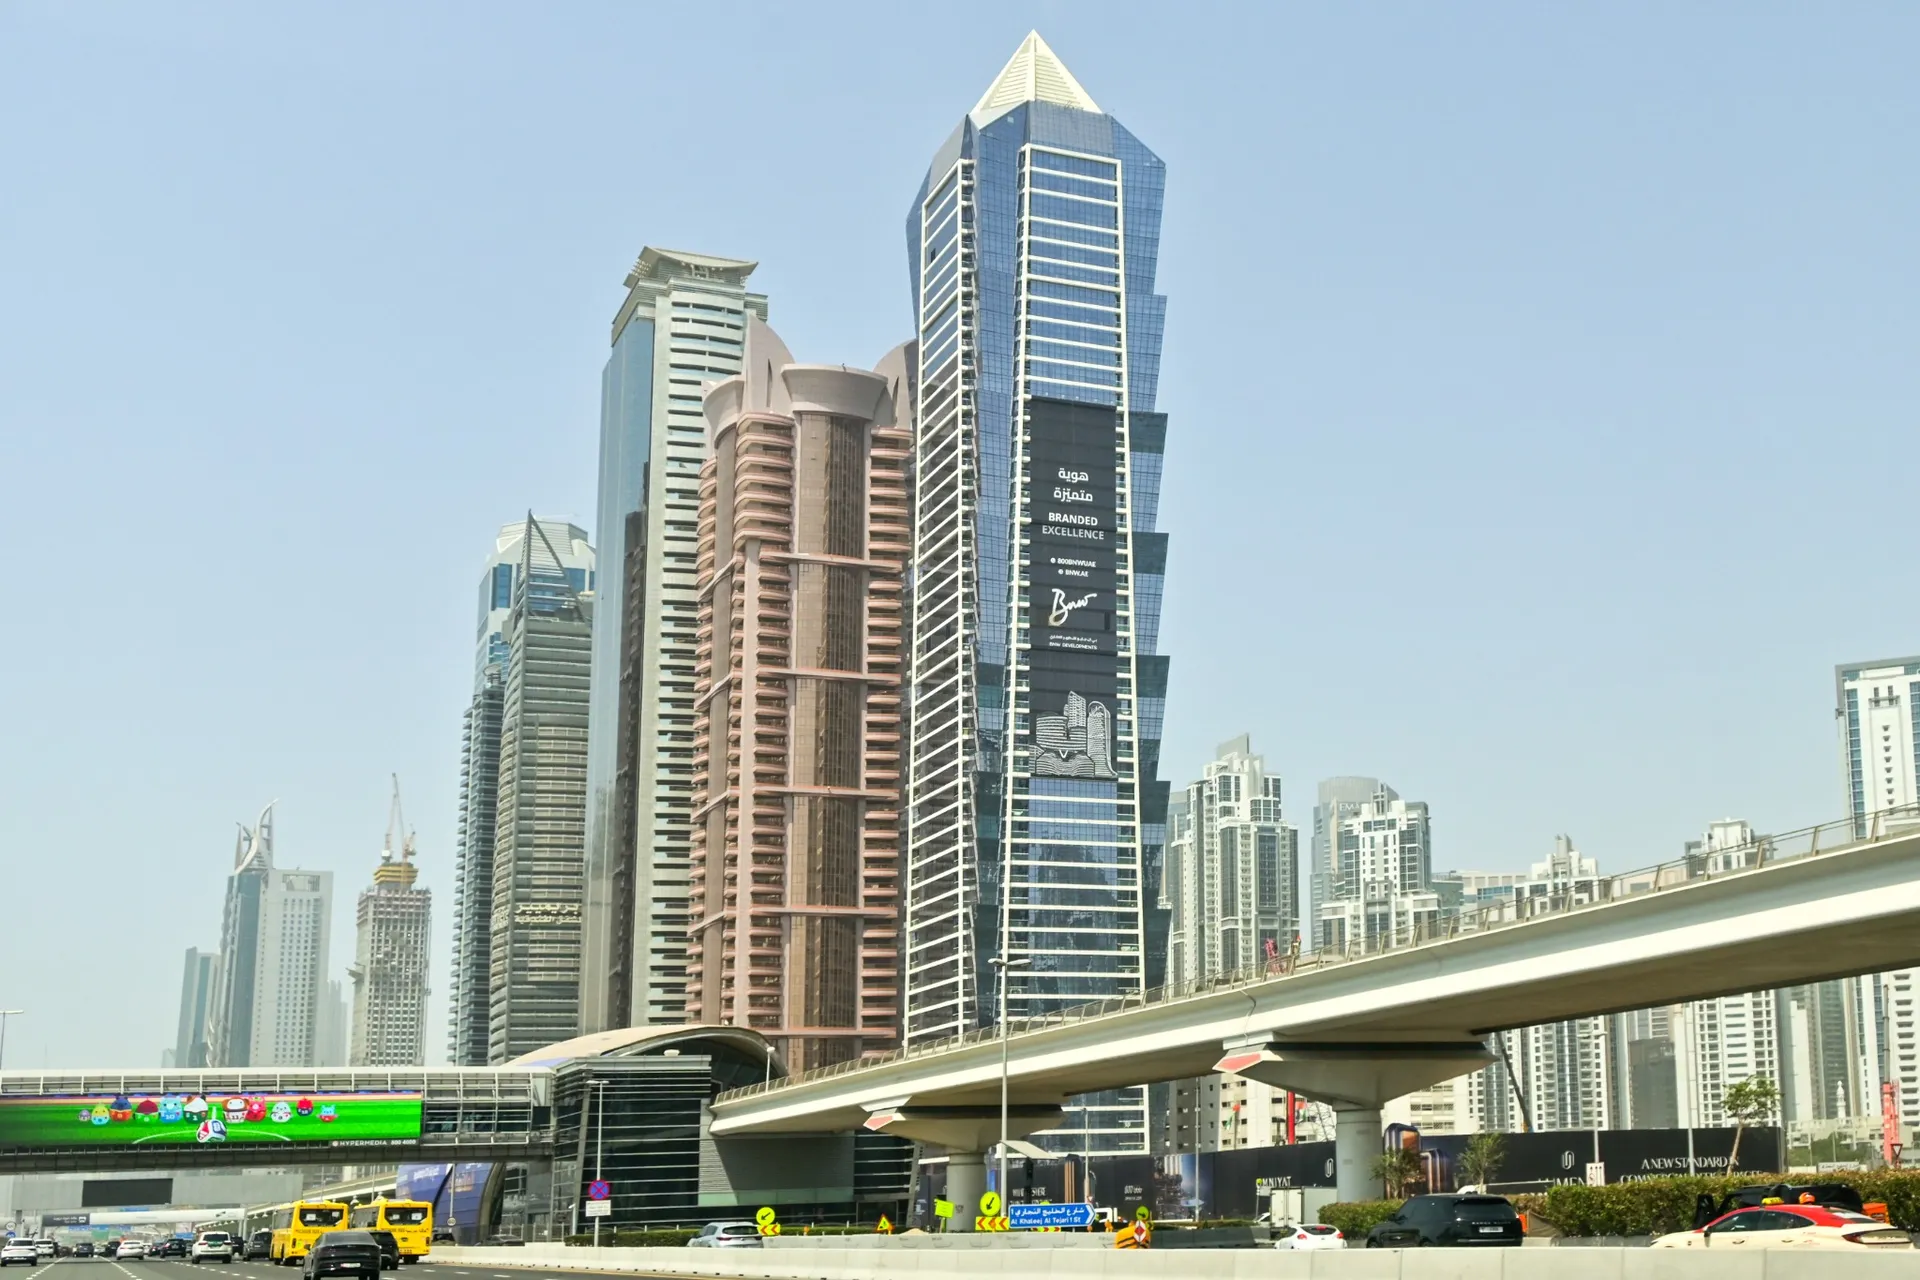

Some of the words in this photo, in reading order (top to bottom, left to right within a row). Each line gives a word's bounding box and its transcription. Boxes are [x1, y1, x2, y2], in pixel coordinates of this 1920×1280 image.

[1058, 467, 1089, 483] هوية
[1048, 512, 1098, 526] BRANDED
[1042, 525, 1105, 540] EXCELLENCE
[1641, 1159, 1650, 1169] A
[1651, 1158, 1674, 1169] NEW
[1675, 1156, 1728, 1168] STANDARD
[1257, 1176, 1291, 1187] MNIYAT
[1015, 1208, 1041, 1217] التجاري
[1042, 1207, 1066, 1217] الخليج
[1066, 1208, 1085, 1217] شارع
[1020, 1217, 1042, 1225] Khaleej
[1053, 1217, 1069, 1225] Tejari
